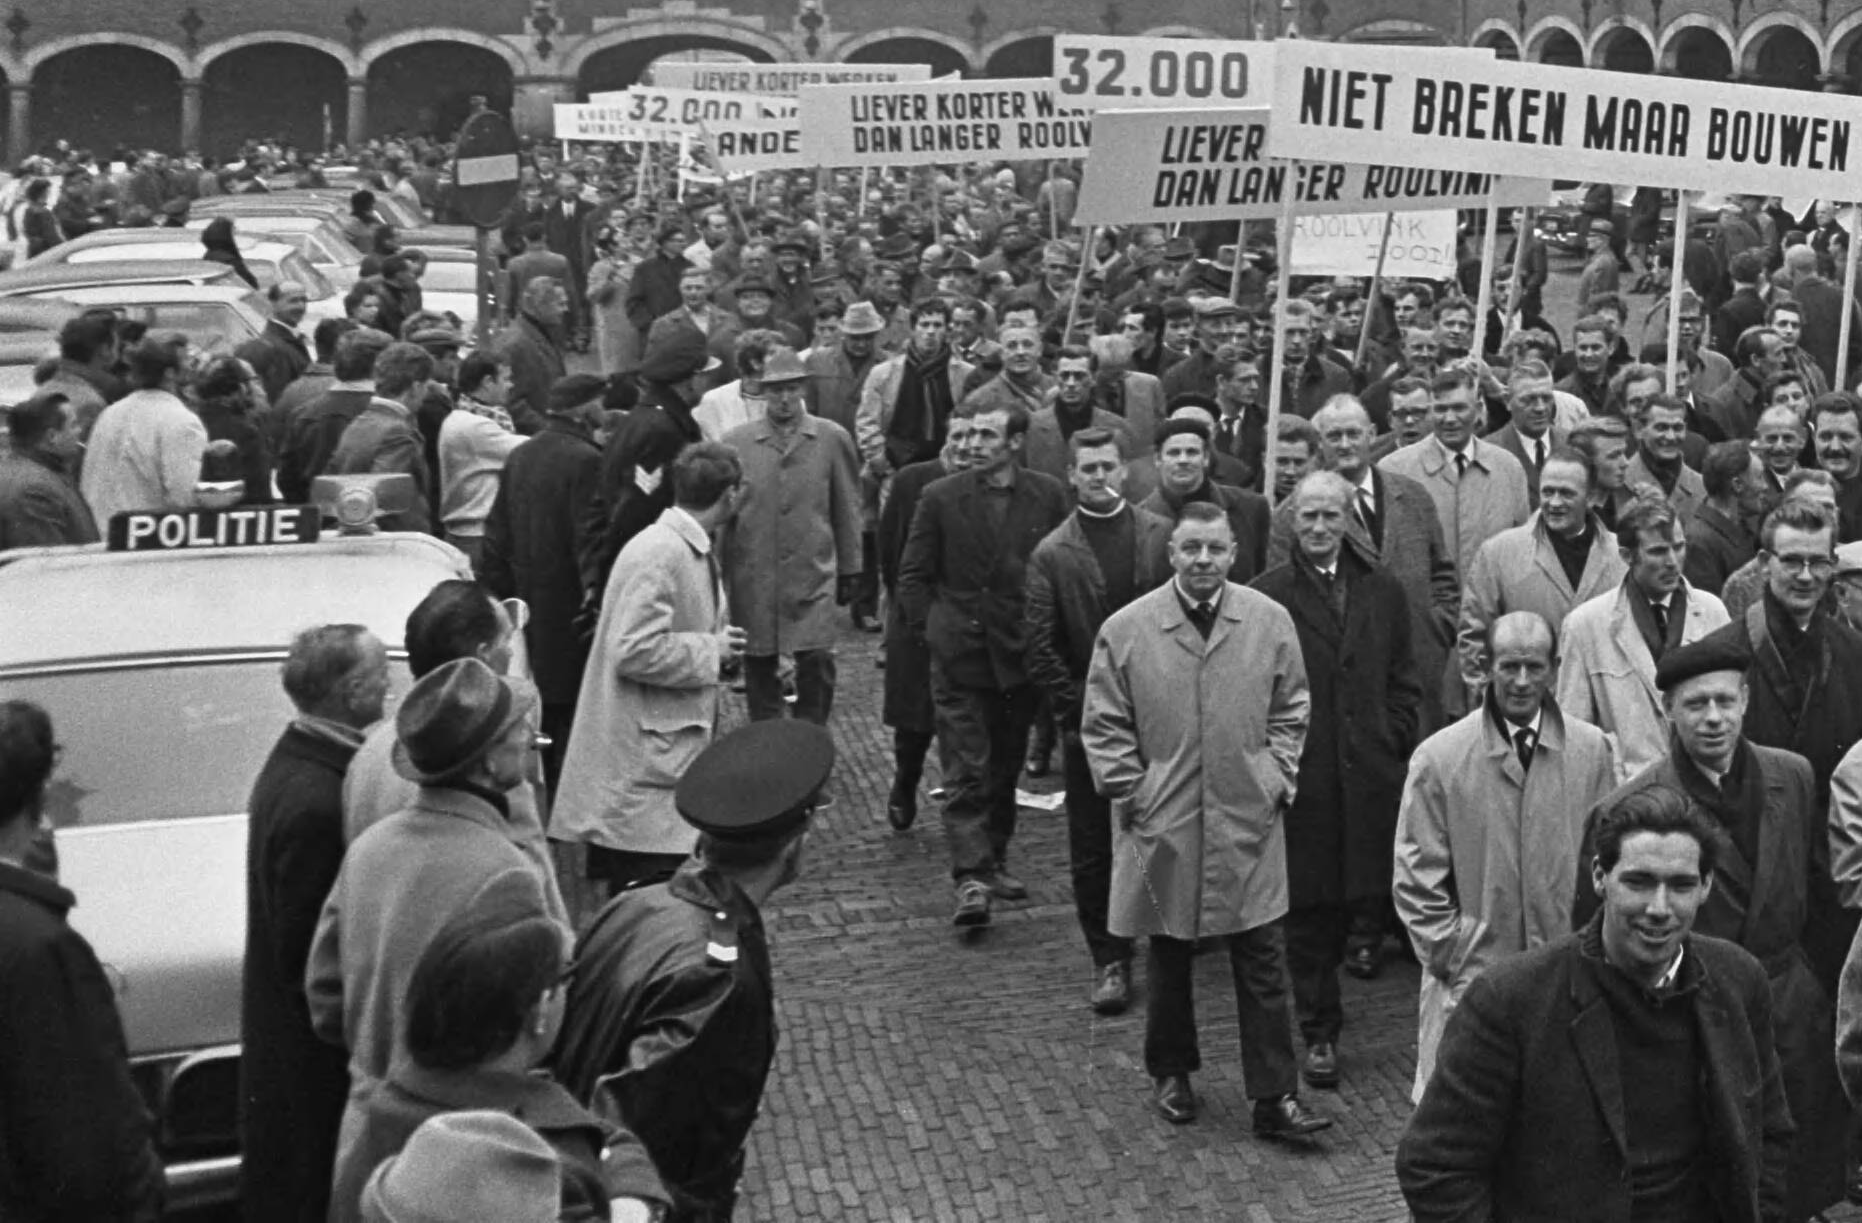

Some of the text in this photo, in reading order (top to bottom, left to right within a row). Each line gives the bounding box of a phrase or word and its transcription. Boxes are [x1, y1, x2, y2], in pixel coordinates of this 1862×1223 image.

[1060, 47, 1249, 98] 32.000
[851, 94, 928, 123] LIEVER
[937, 91, 1025, 120] KORTER
[1299, 66, 1851, 172] NIET BREKEN MAAR BOUWEN
[853, 124, 902, 154] DAN
[910, 122, 1001, 152] LANGER
[1160, 124, 1266, 165] LIEVER
[1152, 168, 1223, 208] DAN
[127, 508, 300, 549] POLITIE
